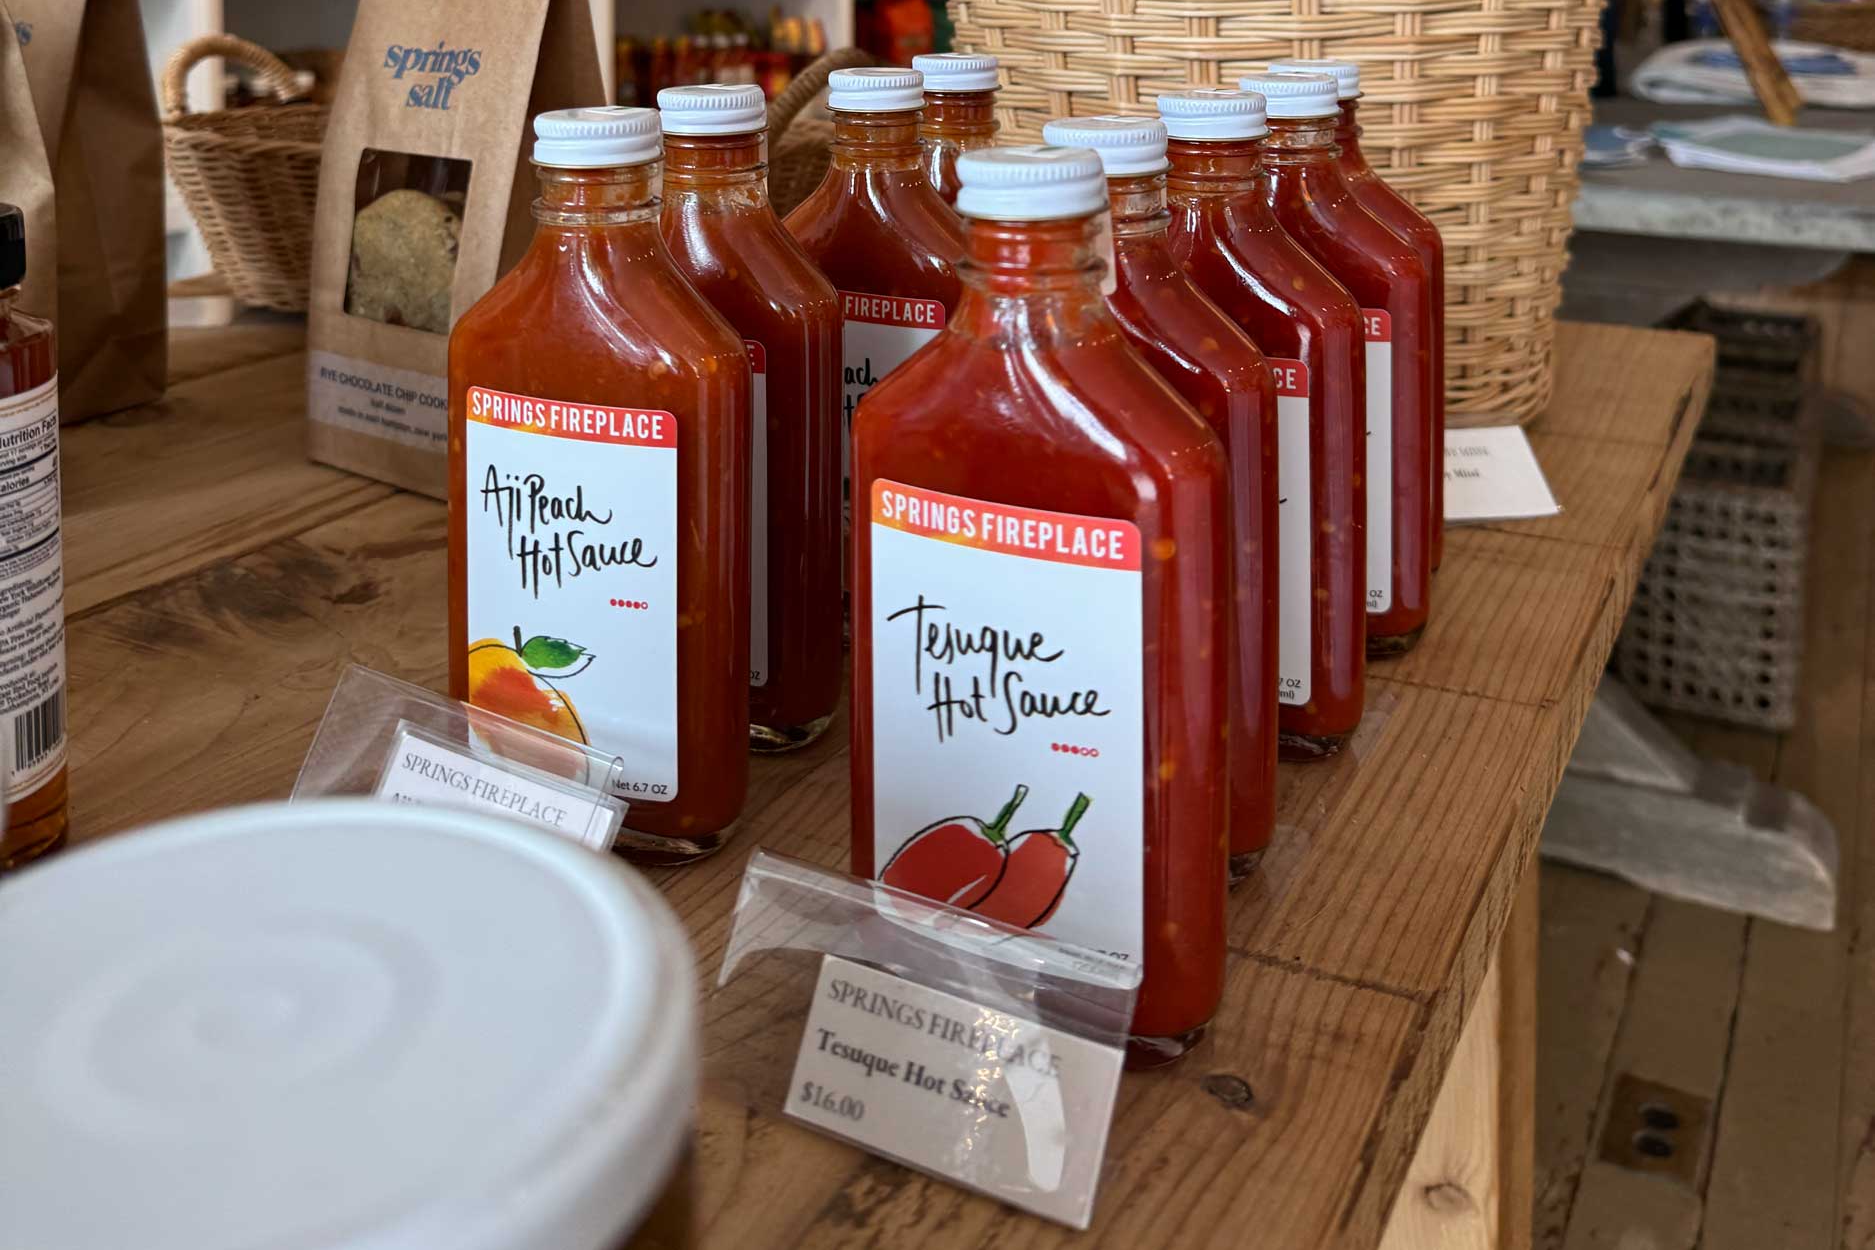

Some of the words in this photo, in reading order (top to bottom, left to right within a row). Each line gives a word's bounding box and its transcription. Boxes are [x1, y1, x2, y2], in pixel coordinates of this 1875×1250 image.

[384, 40, 482, 87] springs
[405, 75, 455, 110] salt
[844, 295, 936, 324] FIREPLACE
[320, 366, 338, 382] RYE
[338, 372, 395, 398] CHOCOLATE
[395, 386, 418, 402] CHIP
[418, 393, 448, 410] COOK
[472, 391, 547, 428] SPRINGS
[550, 406, 664, 440] FIREPLACE
[0, 476, 30, 493] alories
[480, 464, 522, 561] Aji
[522, 473, 613, 535] Peach
[881, 490, 977, 538] SPRINGS
[981, 513, 1125, 561] FIREPLACE
[516, 532, 565, 600] Hot
[567, 530, 658, 577] Sauce
[887, 595, 1065, 699] Tesuque
[927, 671, 988, 743] Hot
[994, 670, 1111, 735] Sauce
[1286, 678, 1301, 688] OZ
[402, 752, 472, 792] SPRINGS
[473, 778, 568, 828] FIREPLACE
[612, 779, 630, 792] Net
[632, 781, 648, 793] 6.7
[651, 784, 668, 795] OZ
[828, 979, 924, 1031] SPRINGS
[818, 1028, 898, 1077] Tesuque
[903, 1061, 948, 1095] Hot
[800, 1081, 865, 1121] $16.00
